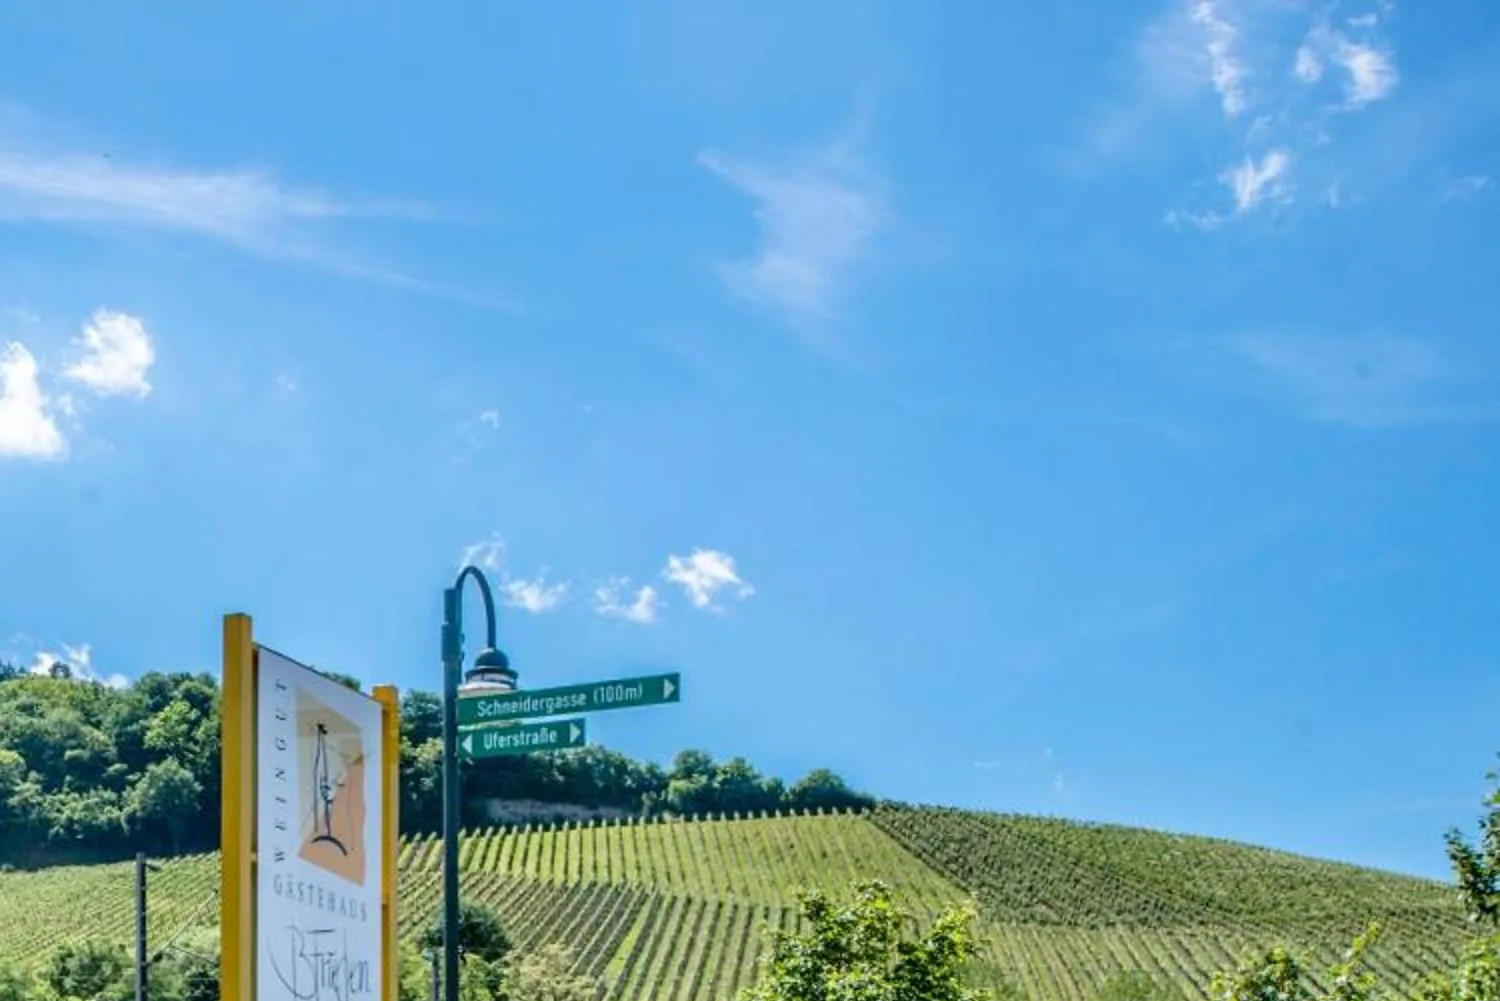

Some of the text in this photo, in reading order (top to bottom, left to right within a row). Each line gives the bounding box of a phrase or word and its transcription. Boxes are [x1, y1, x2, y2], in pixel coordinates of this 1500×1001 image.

[476, 682, 643, 718] Schneidergasse (100m)
[483, 727, 557, 750] Uferstraße
[273, 873, 367, 922] GÄSTEHAUS
